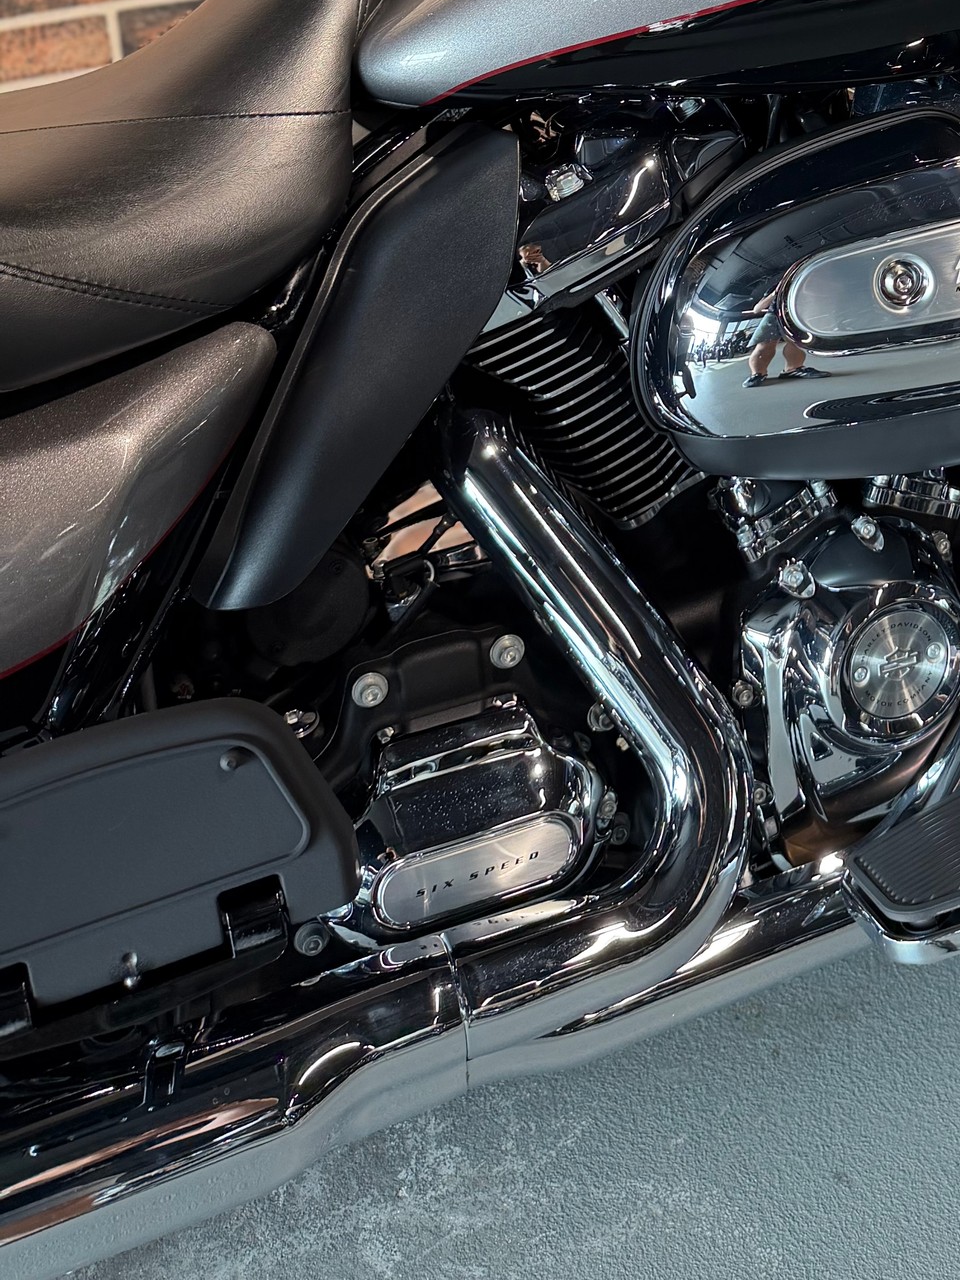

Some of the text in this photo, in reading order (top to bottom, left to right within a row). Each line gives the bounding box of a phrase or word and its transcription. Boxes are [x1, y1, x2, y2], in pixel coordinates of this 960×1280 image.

[865, 670, 933, 708] MOTOR COMPANY
[415, 850, 540, 898] SIX SPEED
